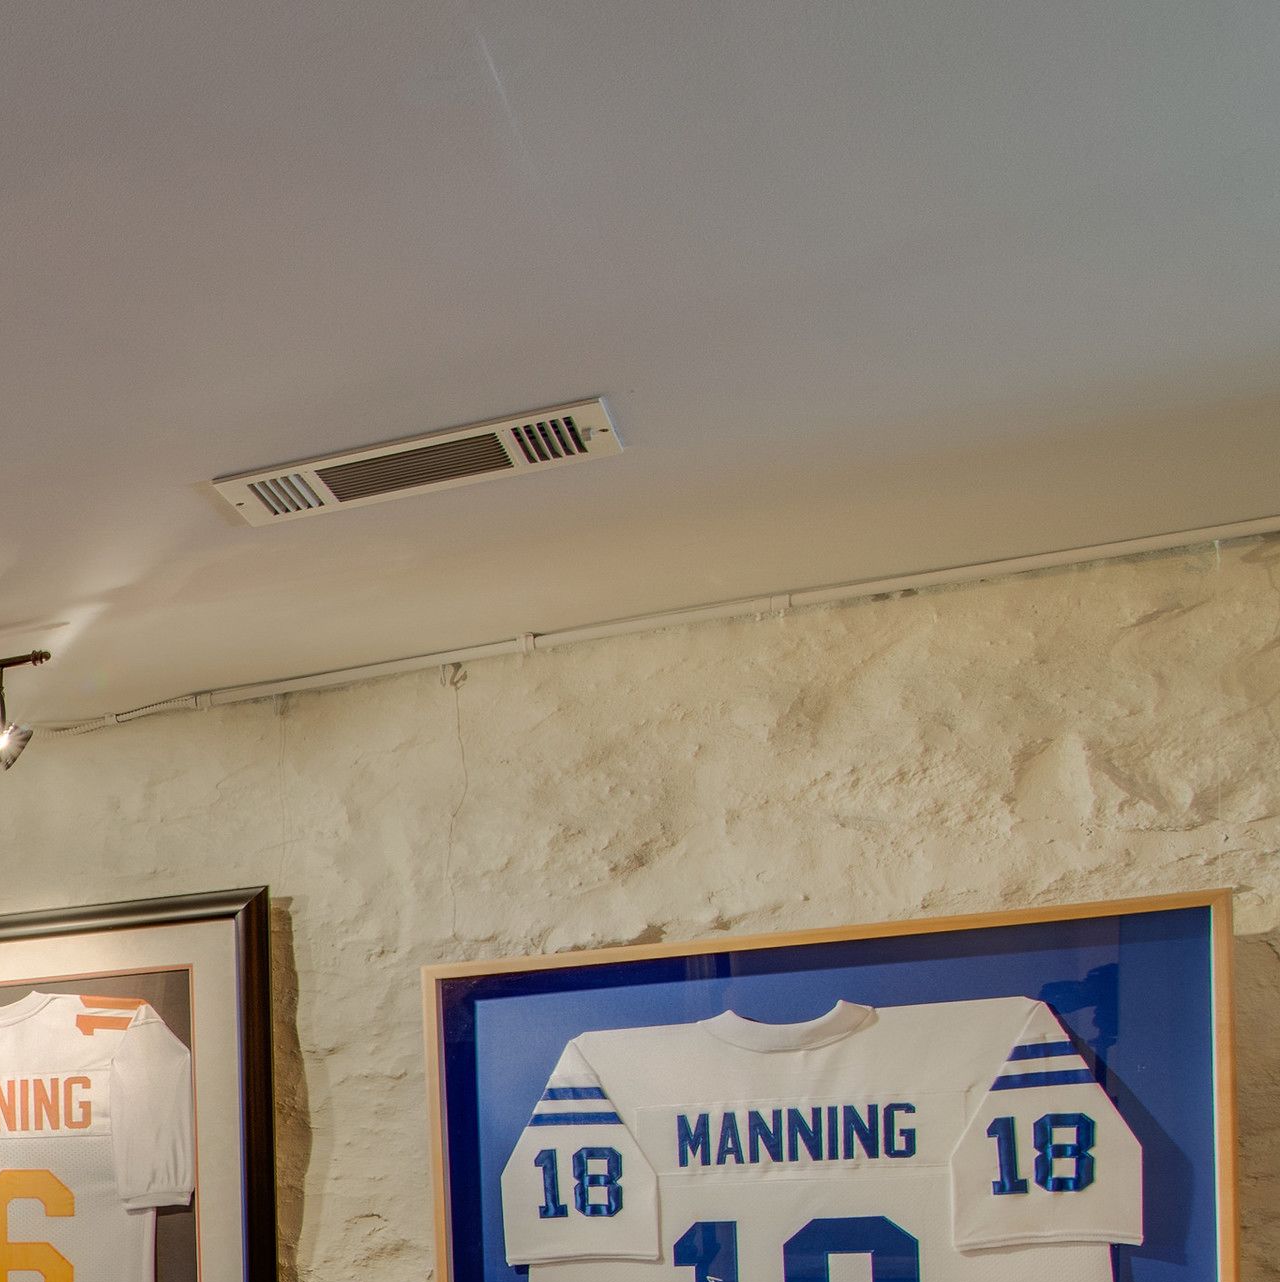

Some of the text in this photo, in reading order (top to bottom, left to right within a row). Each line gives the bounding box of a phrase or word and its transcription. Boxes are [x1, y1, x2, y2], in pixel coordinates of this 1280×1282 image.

[677, 1102, 917, 1168] MANNING
[986, 1112, 1096, 1196] 18
[533, 1146, 623, 1219] 18
